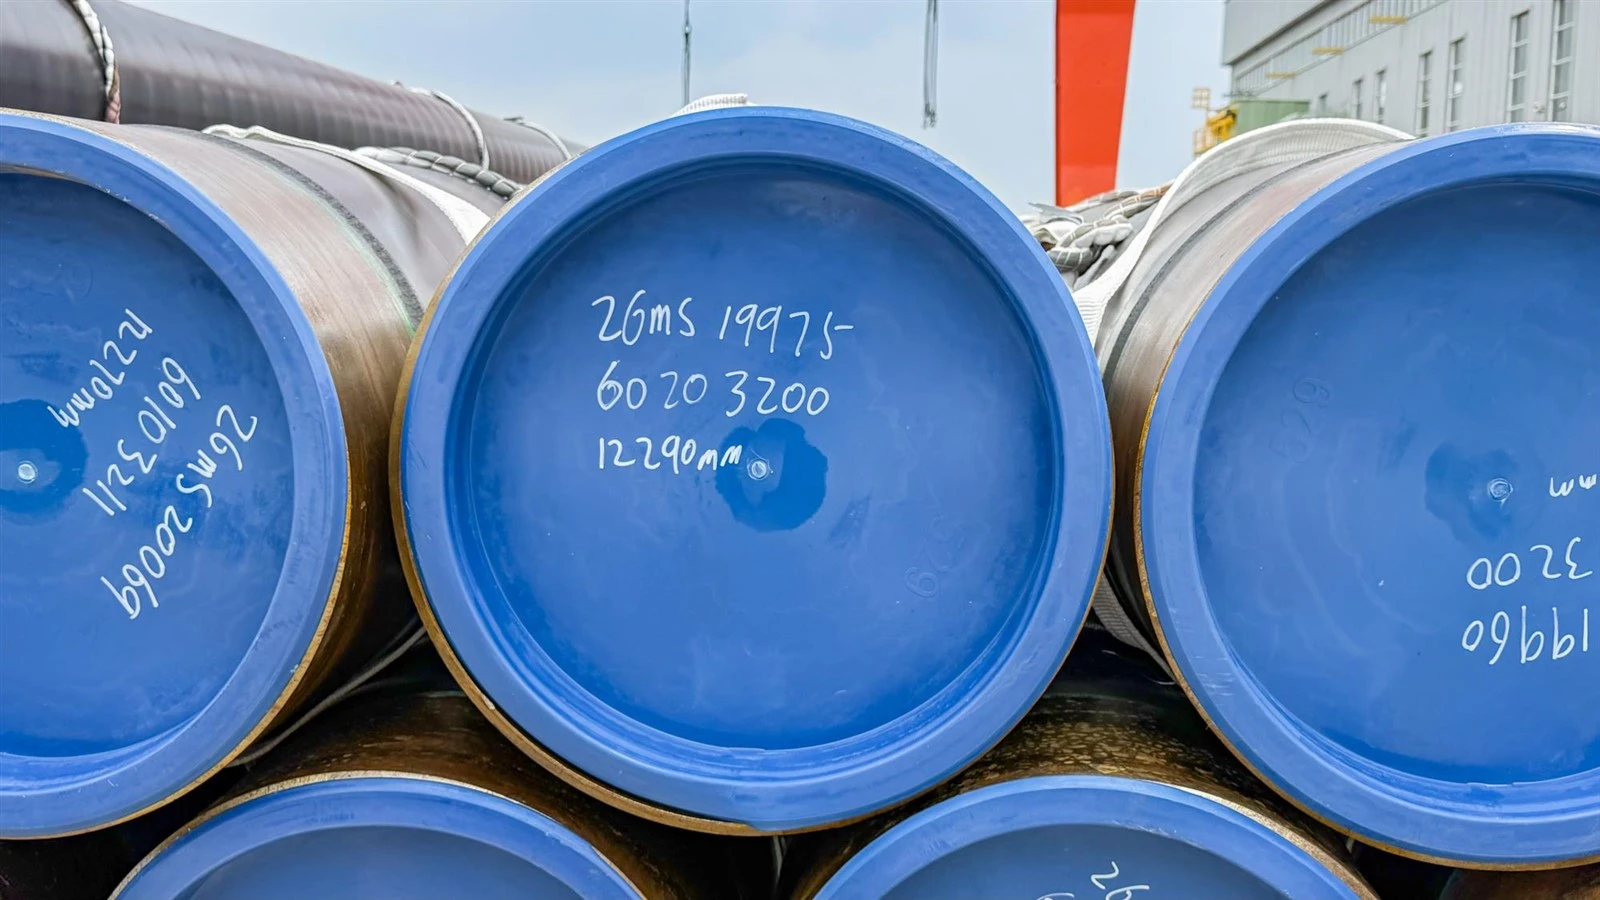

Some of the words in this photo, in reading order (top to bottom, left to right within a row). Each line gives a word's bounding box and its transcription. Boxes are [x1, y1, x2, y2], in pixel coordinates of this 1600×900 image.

[718, 303, 854, 361] 19975
[724, 370, 830, 418] 3200
[81, 438, 158, 517] 3211
[100, 504, 193, 620] 20069
[1466, 536, 1593, 590] 3200
[1461, 604, 1589, 665] 19960
